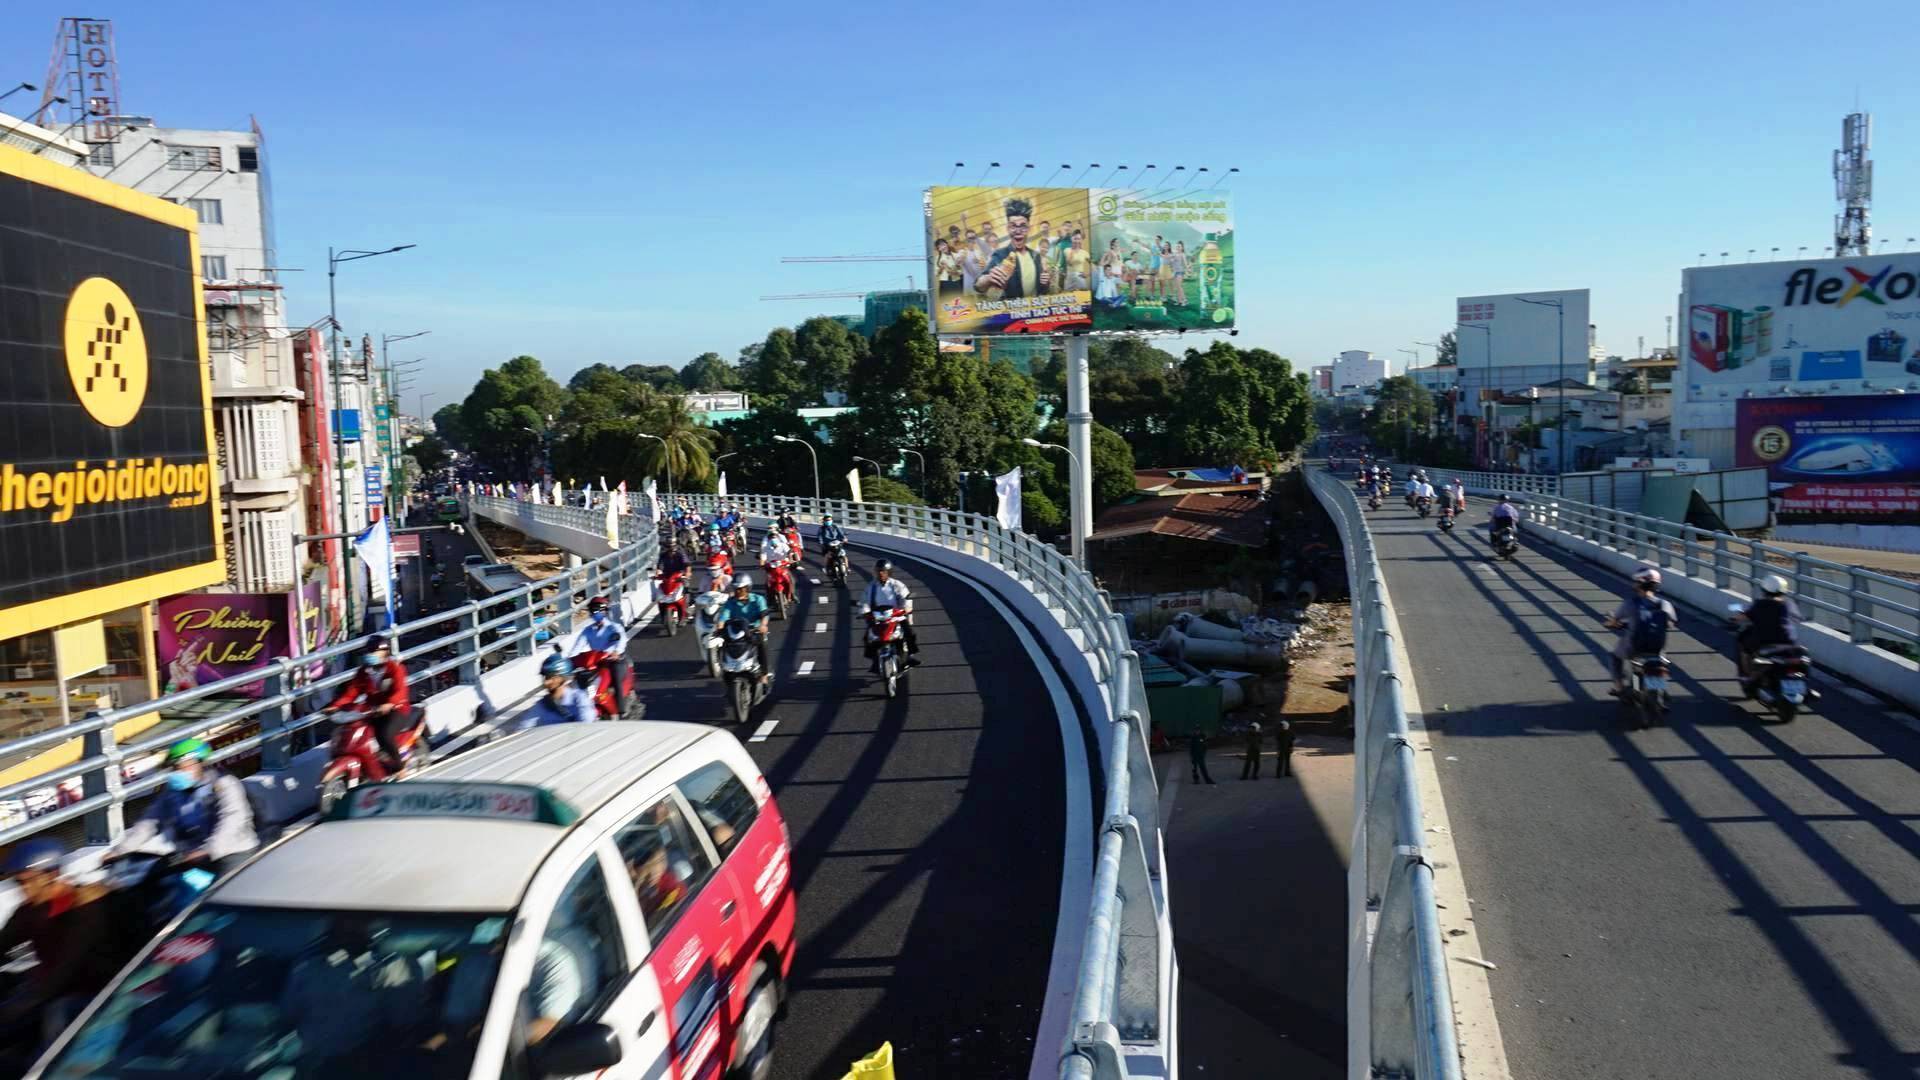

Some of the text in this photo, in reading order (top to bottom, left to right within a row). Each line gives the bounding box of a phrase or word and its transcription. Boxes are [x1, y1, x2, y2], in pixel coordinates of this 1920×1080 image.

[82, 24, 113, 139] HOTEL
[0, 457, 209, 523] hegioididong
[196, 641, 264, 665] Nail
